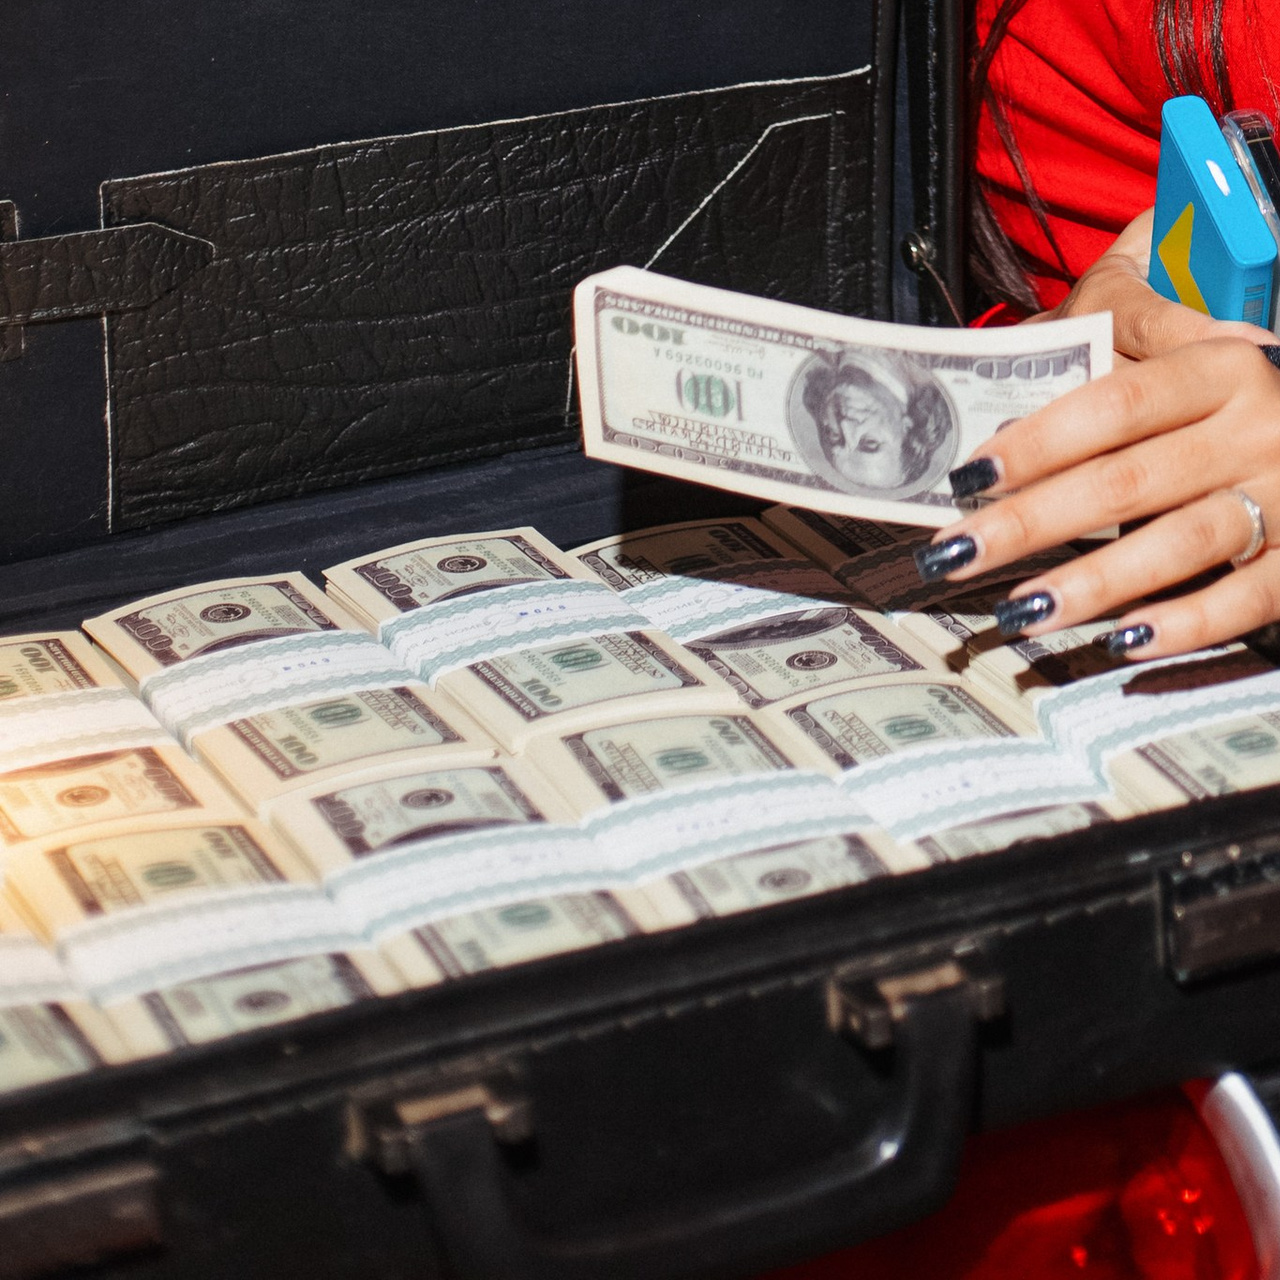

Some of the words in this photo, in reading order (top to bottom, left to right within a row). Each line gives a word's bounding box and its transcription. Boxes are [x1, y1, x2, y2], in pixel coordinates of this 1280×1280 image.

[611, 316, 686, 346] 100
[520, 677, 563, 707] 100
[277, 734, 320, 766] 100
